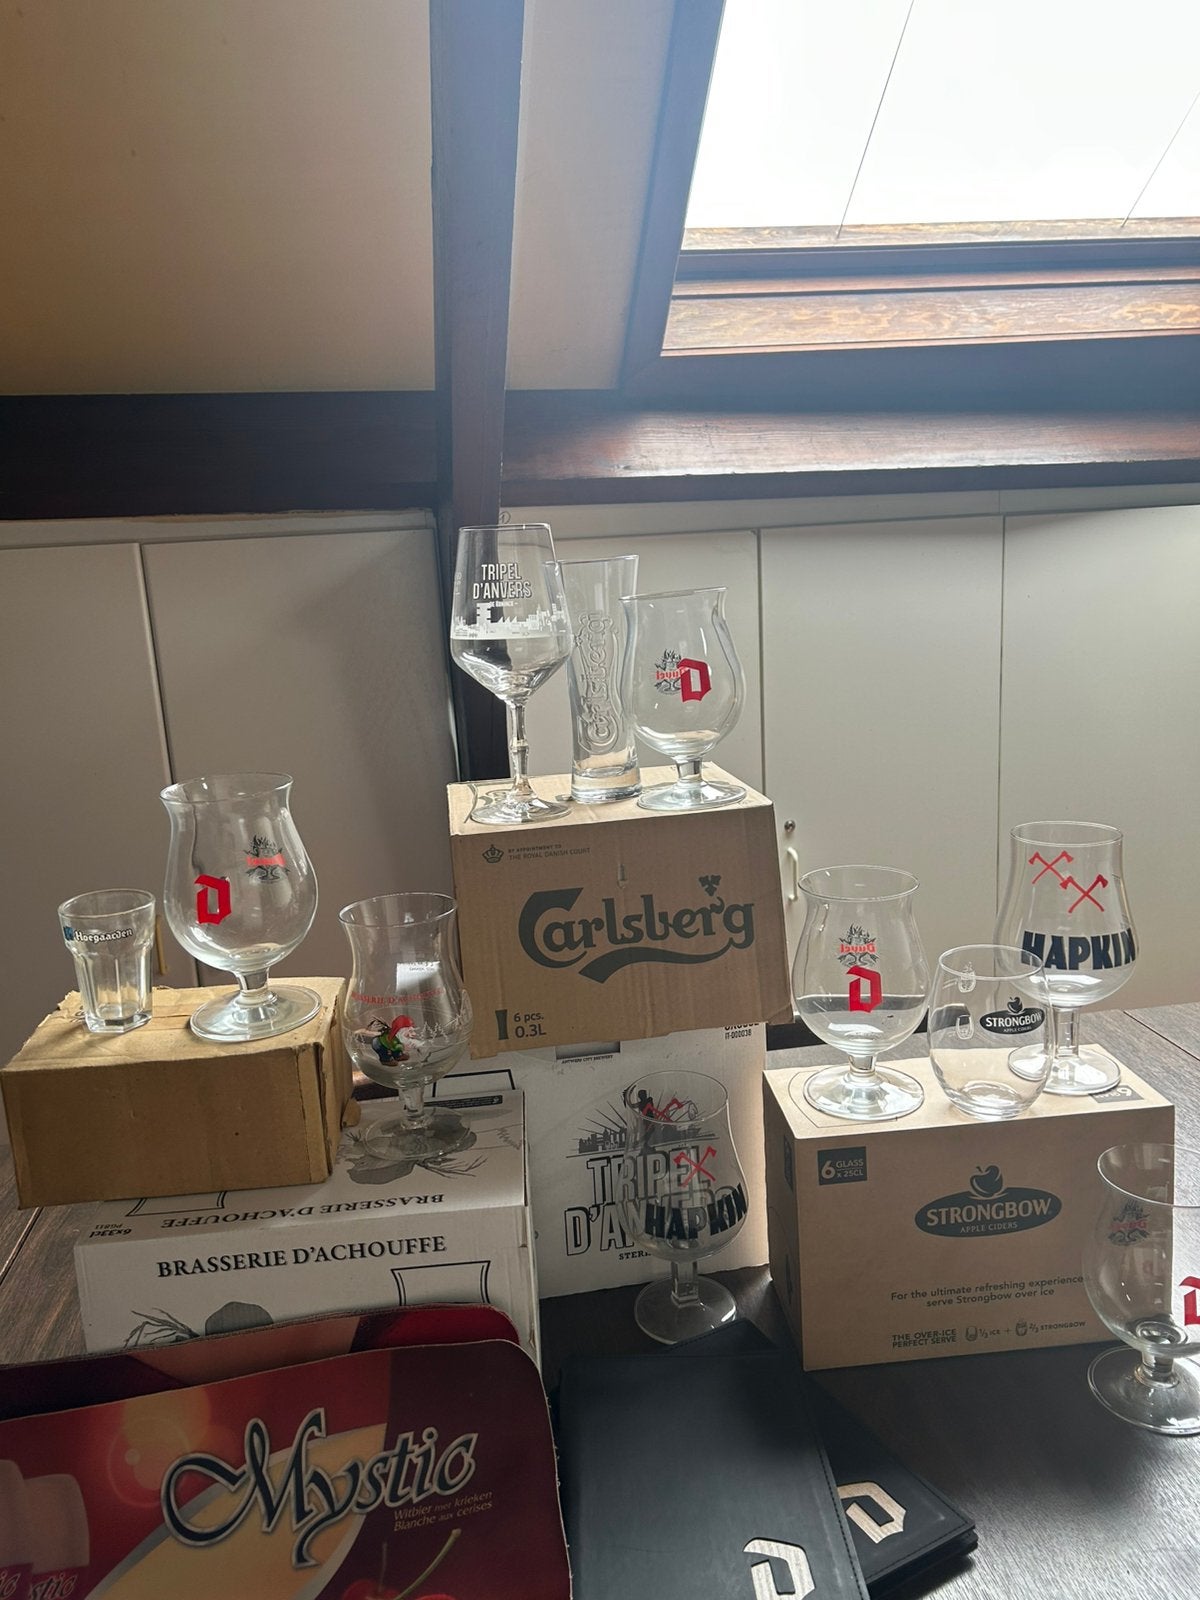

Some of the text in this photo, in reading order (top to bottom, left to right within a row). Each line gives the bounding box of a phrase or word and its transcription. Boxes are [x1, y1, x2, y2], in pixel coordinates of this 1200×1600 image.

[481, 563, 522, 581] TRIPEL
[473, 581, 532, 600] D'ANVERS
[677, 658, 712, 703] D
[545, 848, 568, 857] DANISH
[570, 847, 590, 855] COURT
[194, 874, 232, 926] D
[74, 928, 133, 944] Hoegaarden
[518, 887, 755, 970] Carlsberg
[1020, 927, 1136, 971] HAPKIN
[846, 965, 882, 1013] D
[512, 1011, 545, 1023] 6 pcs.
[985, 1012, 1042, 1029] STRONGBOW
[514, 1023, 547, 1039] 0.3L
[821, 1160, 836, 1180] 6
[835, 1158, 864, 1169] GLASS
[844, 1168, 864, 1178] 25CL
[160, 1192, 445, 1229] BRASSERIE D'ACHOUFFE
[645, 1182, 748, 1240] HAPKIN
[926, 1199, 1051, 1227] STRONGBOW
[89, 1229, 132, 1239] 6x33cl
[960, 1221, 1018, 1234] APPLE CIDERS
[156, 1235, 447, 1278] BRASSERIE D'ACHOUFFE
[618, 1251, 651, 1260] STER
[891, 1275, 1085, 1301] For the ultimate refreshing experience
[927, 1288, 1055, 1307] serve Strongbow over ice
[913, 1328, 957, 1339] OVER-ICE
[1040, 1321, 1086, 1331] STRONGBOW
[892, 1336, 957, 1348] PERFECT SERVE
[161, 1408, 479, 1569] Mystic
[393, 1505, 431, 1520] Witbier
[454, 1491, 493, 1507] krieken
[393, 1515, 436, 1532] Blanche
[456, 1501, 493, 1517] cerises
